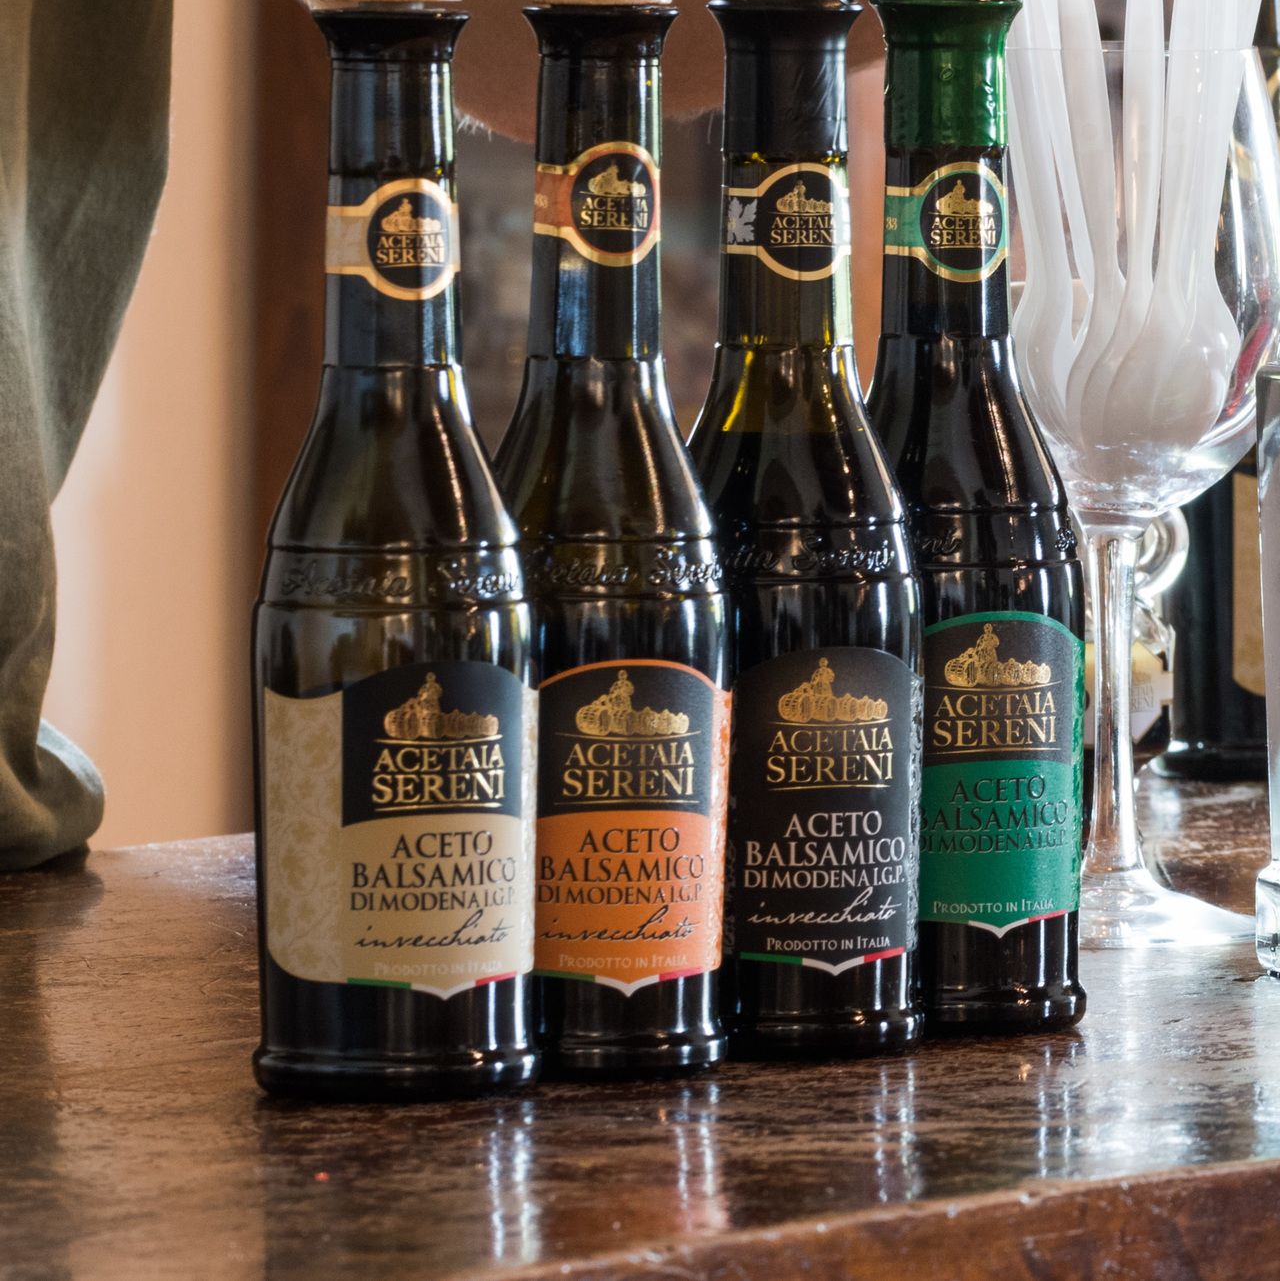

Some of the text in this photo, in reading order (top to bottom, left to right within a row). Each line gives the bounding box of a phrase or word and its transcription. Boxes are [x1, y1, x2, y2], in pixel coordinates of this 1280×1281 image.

[580, 211, 648, 228] SERENI
[770, 229, 839, 245] SERENI
[930, 229, 996, 246] SERENI
[376, 248, 446, 265] SERENI
[936, 690, 1057, 718] ACETAIA
[768, 727, 893, 753] ACETAIA
[932, 716, 1057, 748] SERENI
[373, 746, 505, 772] ACETAIA
[565, 741, 695, 767] ACETAIA
[766, 752, 893, 783] SERENI
[372, 770, 505, 805] SERENI
[562, 766, 694, 797] SERENI
[951, 775, 1046, 804] ACETO
[783, 809, 882, 838] ACETO
[391, 830, 493, 858] ACETO
[578, 827, 680, 854] ACETO
[745, 836, 906, 867] BALSAMICO
[937, 833, 1030, 853] MODENA
[352, 857, 516, 889] BALSAMICO
[540, 855, 704, 883] BALSAMICO
[744, 865, 905, 888] DI MODENA I.G.P.
[350, 891, 374, 911] DI
[379, 891, 482, 911] MODENA
[537, 885, 560, 904] DI
[566, 885, 665, 905] MODENA
[747, 886, 902, 925] invecchiato
[355, 909, 514, 948] invecchiato
[539, 904, 698, 941] invecchiato
